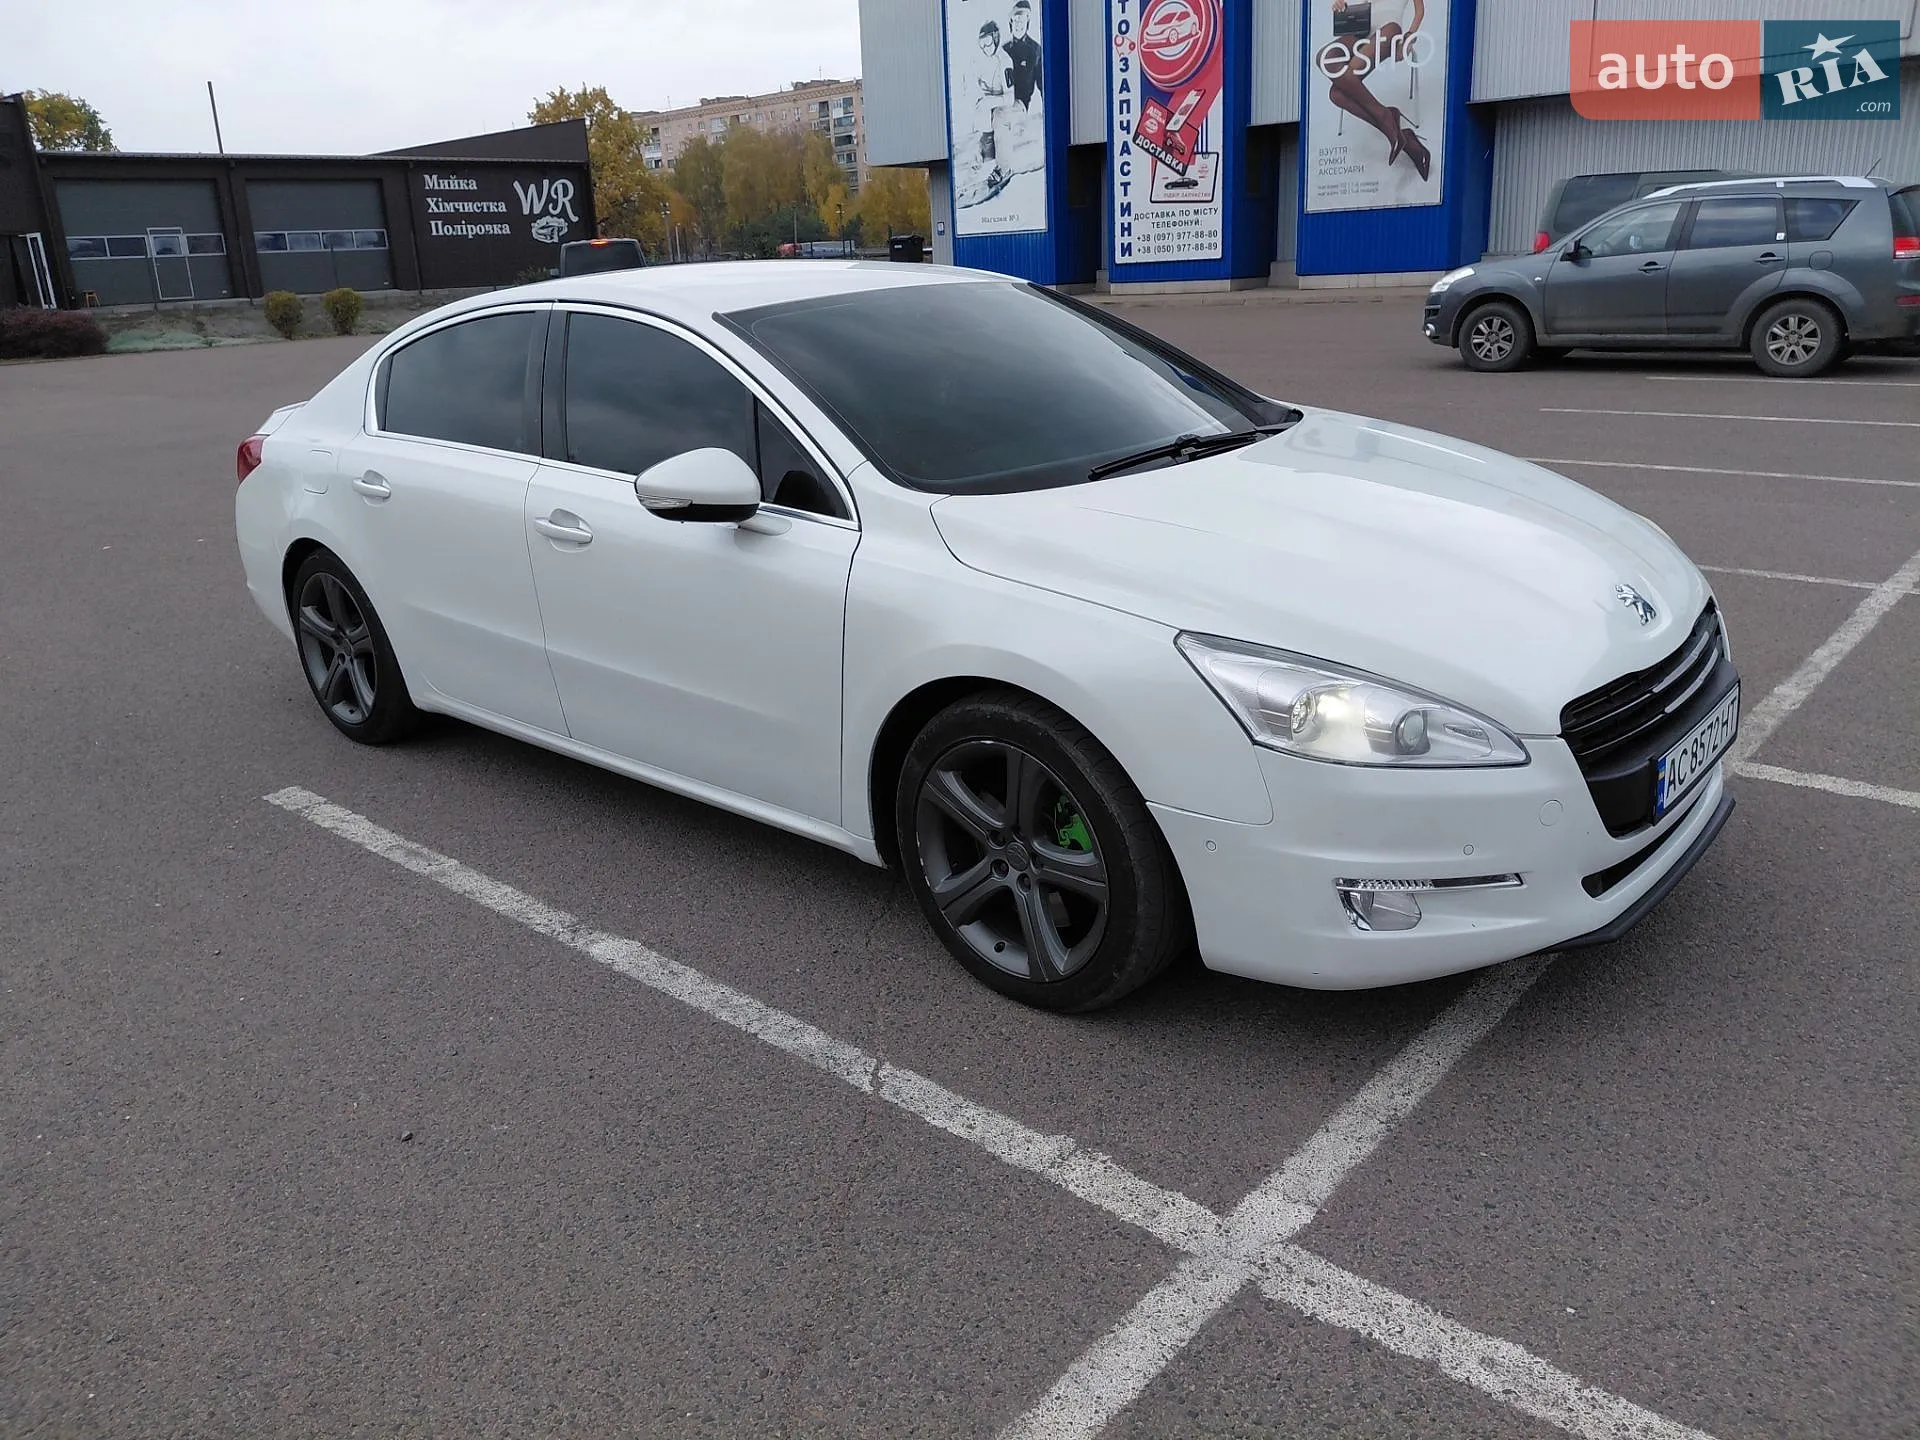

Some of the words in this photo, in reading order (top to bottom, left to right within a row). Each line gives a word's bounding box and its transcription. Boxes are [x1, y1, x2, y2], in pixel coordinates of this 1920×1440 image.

[1320, 29, 1435, 79] estro
[1135, 135, 1185, 173] ДОСТАВКА
[1319, 146, 1348, 157] ВЗУТТЯ
[1319, 156, 1346, 166] СУМКИ
[1319, 165, 1365, 176] АКСЕСУАРИ
[423, 174, 478, 191] Мийка
[425, 197, 507, 213] Хімчистка
[512, 178, 579, 222] WR
[1133, 210, 1176, 221] ДОСТАВКА
[1178, 209, 1191, 217] ПО
[1193, 207, 1219, 216] МІСТУ
[429, 220, 511, 239] Поліровка
[1151, 218, 1203, 229] ТЕЛЕФОНУЙ:
[1136, 233, 1151, 242] +38
[1153, 232, 1175, 243] (097)
[1136, 245, 1151, 255] +38
[1153, 244, 1175, 255] (050)
